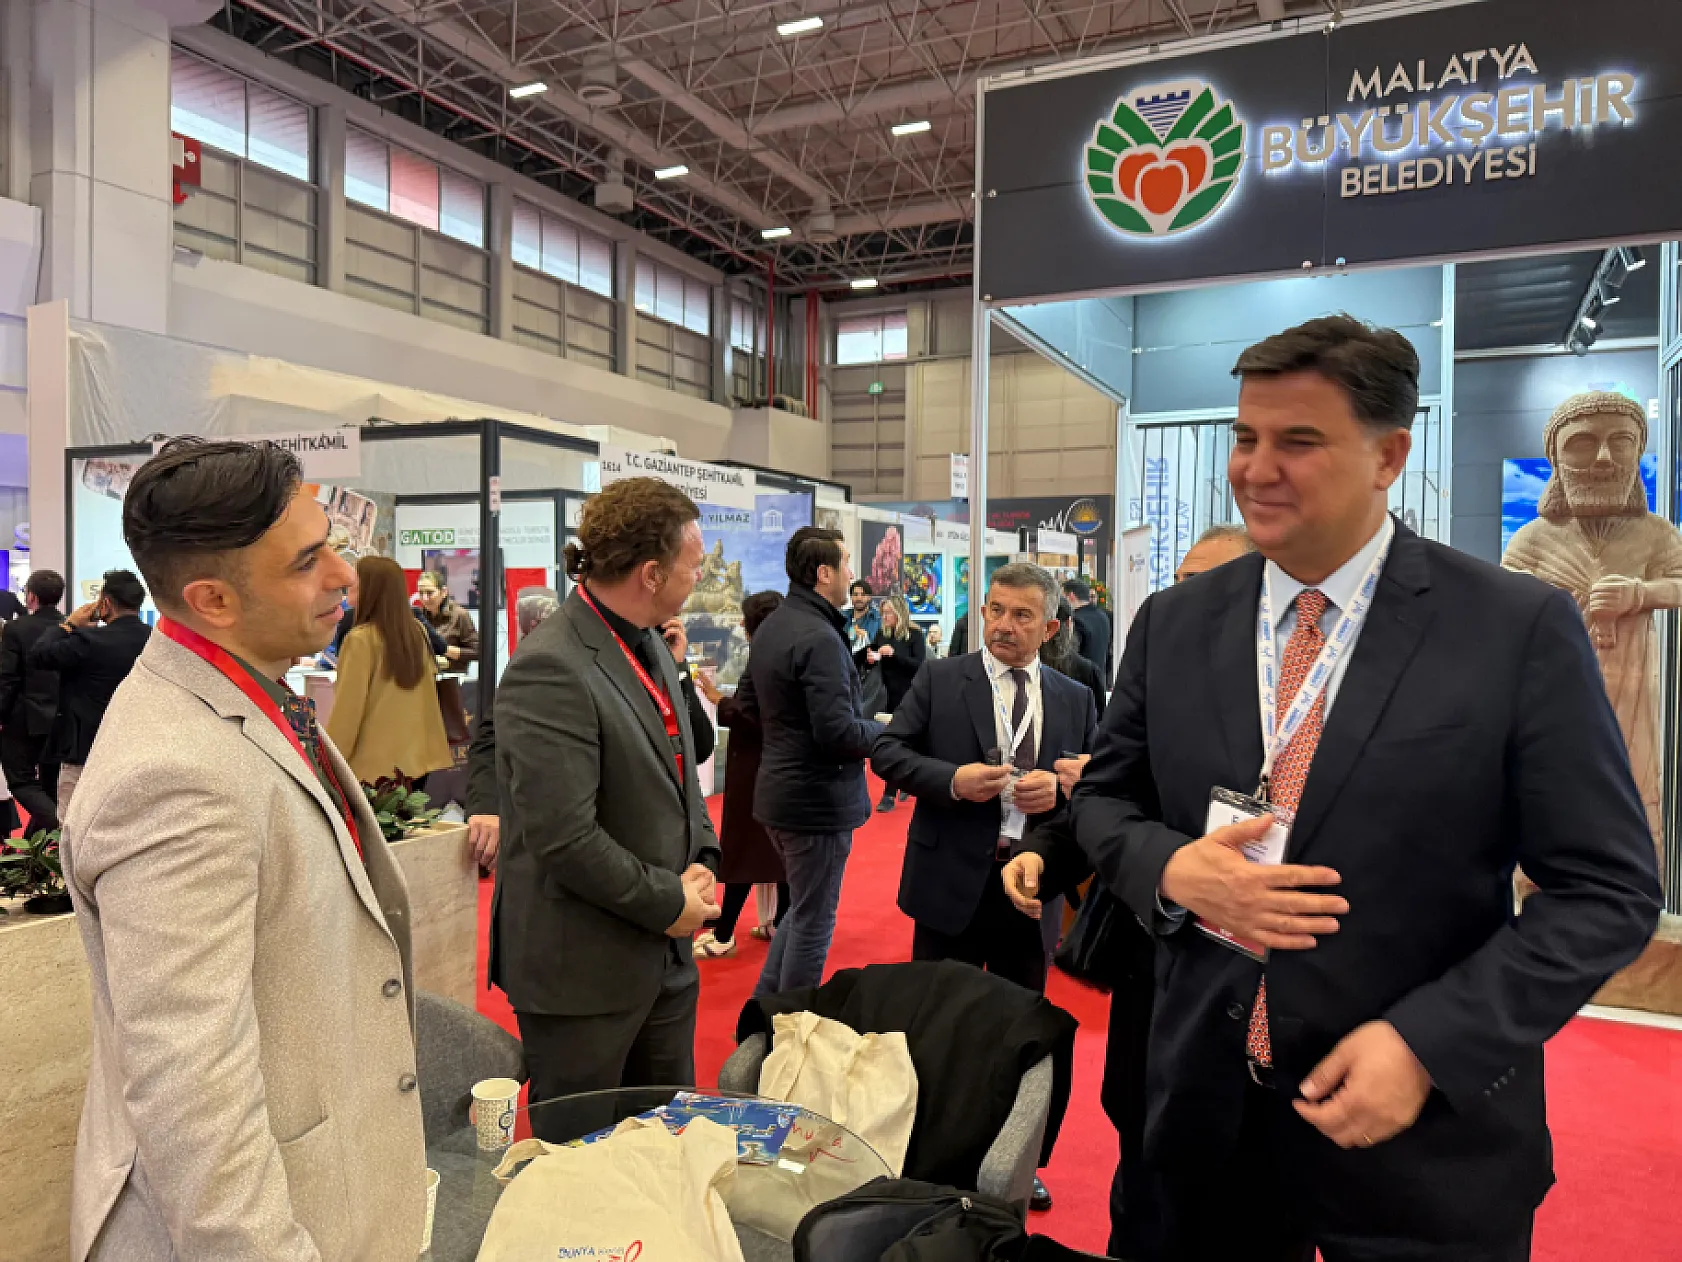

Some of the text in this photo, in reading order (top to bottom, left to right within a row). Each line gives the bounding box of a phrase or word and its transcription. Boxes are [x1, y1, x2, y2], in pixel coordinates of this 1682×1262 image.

[1346, 41, 1539, 102] MALATYA
[1261, 72, 1636, 174] BÜYÜKŞEHİR
[643, 455, 697, 478] GAZİANTEP
[708, 512, 751, 524] YILMAZ
